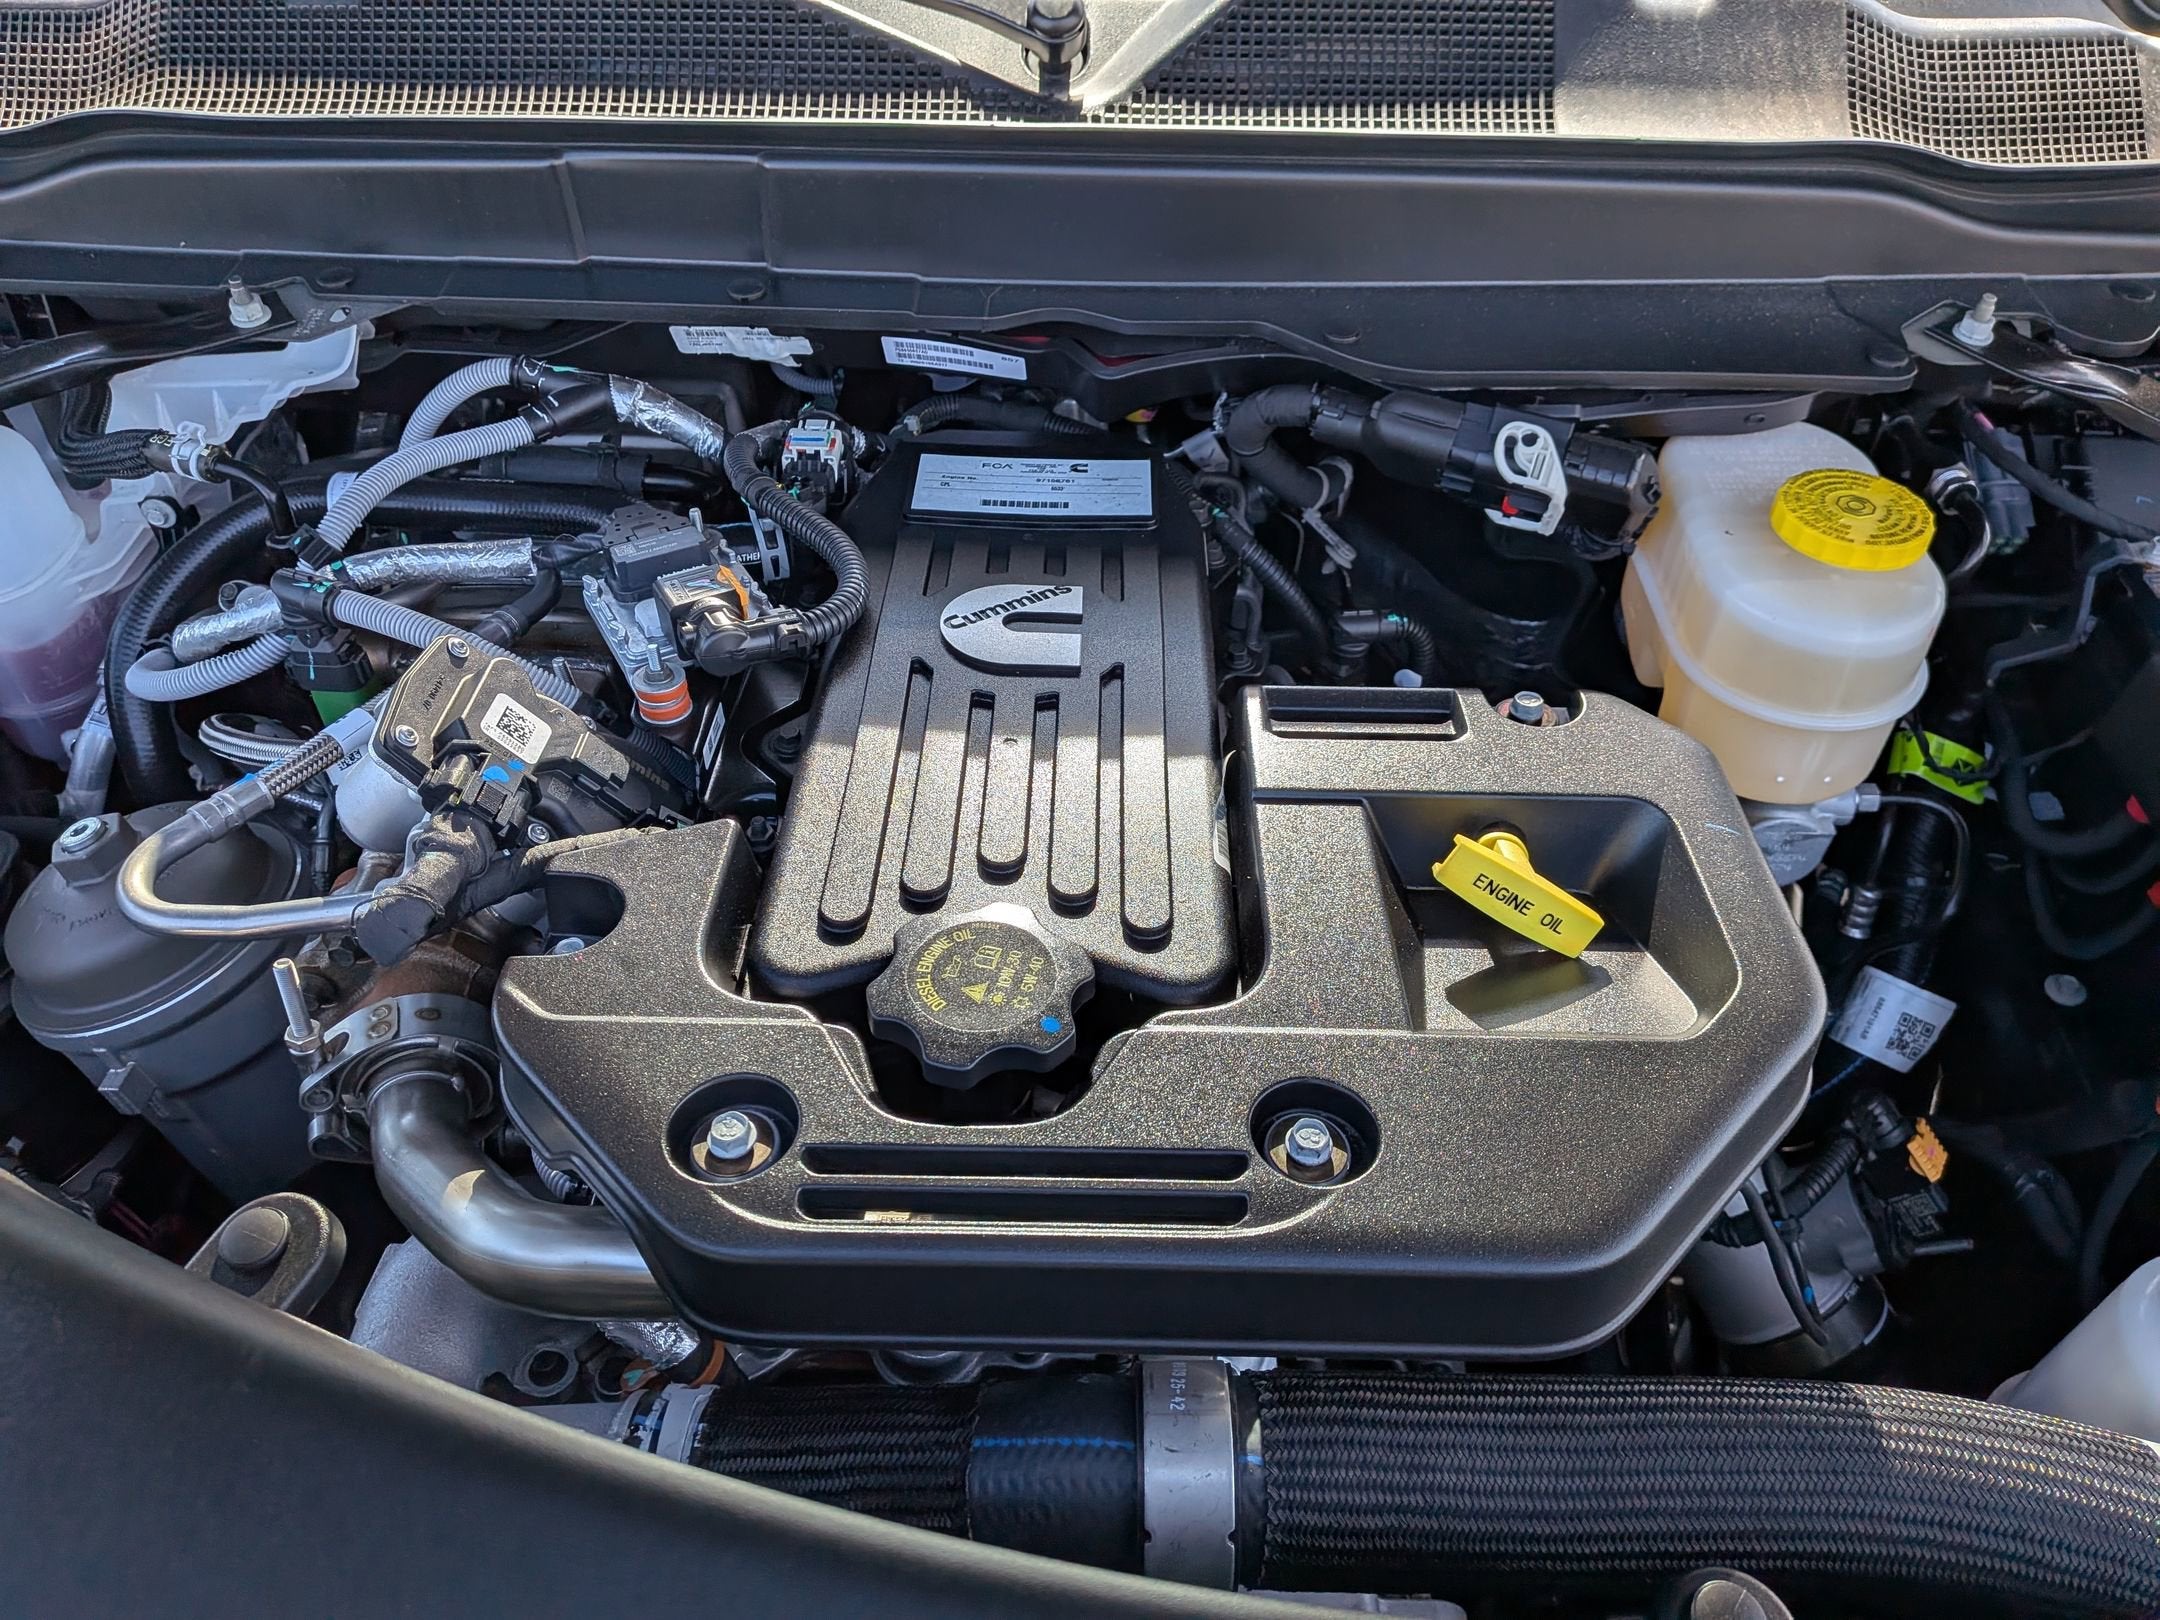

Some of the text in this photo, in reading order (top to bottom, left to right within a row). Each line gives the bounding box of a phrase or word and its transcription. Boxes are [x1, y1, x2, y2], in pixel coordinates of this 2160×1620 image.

[943, 585, 1073, 629] Cummins
[1472, 873, 1564, 935] ENGINE OIL
[915, 928, 976, 1012] DIESEL ENGINE OIL
[997, 949, 1023, 989] 10W-30
[1020, 956, 1045, 992] 5W-40
